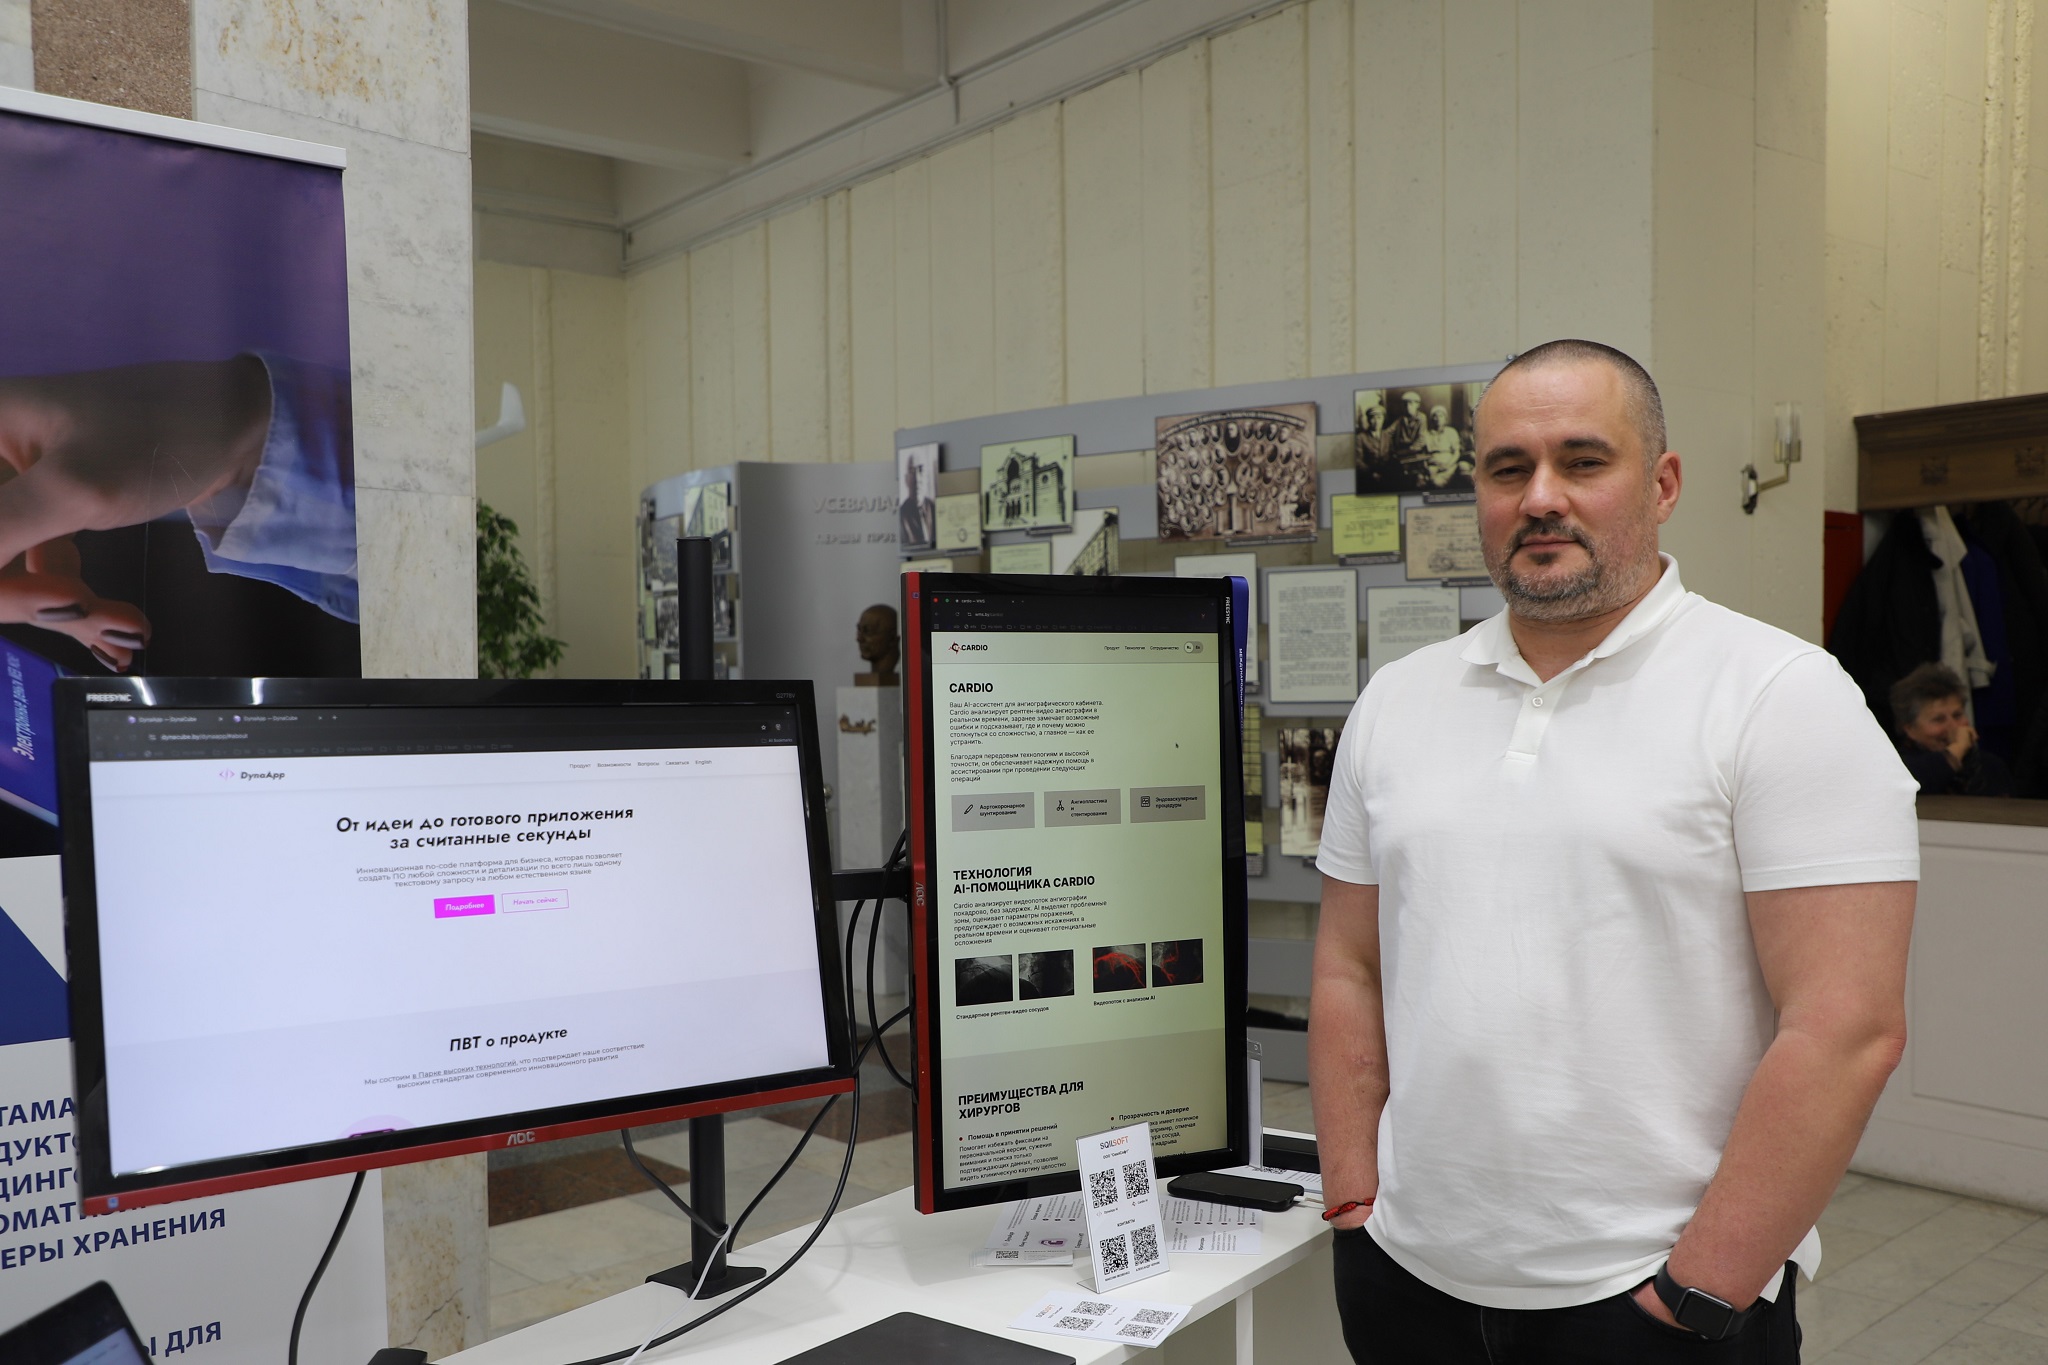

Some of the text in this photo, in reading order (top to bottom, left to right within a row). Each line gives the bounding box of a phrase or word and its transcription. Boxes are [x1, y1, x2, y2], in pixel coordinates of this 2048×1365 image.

[949, 683, 993, 693] CARDIO
[86, 692, 132, 702] FREESYNC
[1017, 700, 1075, 708] ангиографического
[1010, 708, 1054, 716] рентген-видео
[240, 771, 285, 781] DynaApp
[1014, 766, 1051, 774] проведении
[951, 775, 981, 783] операций
[337, 807, 633, 833] От идеи до готового приложения
[390, 829, 591, 849] за считанные секунды
[356, 864, 424, 874] Инновационная
[425, 861, 458, 870] no-code
[460, 859, 503, 869] платформа
[554, 855, 584, 863] которая
[585, 853, 623, 861] позволяет
[358, 874, 391, 882] создать
[392, 872, 406, 880] ПО
[407, 870, 435, 879] любой
[436, 869, 480, 877] сложности
[488, 866, 538, 875] детализации
[594, 861, 621, 869] одному
[395, 878, 441, 887] текстовому
[443, 876, 475, 885] запросу
[488, 873, 514, 881] любом
[516, 870, 568, 879] естественном
[953, 866, 1032, 881] ТЕХНОЛОГИЯ
[953, 875, 1095, 894] AI-ПОМОЩНИКА CARDIO
[445, 901, 485, 911] Подробнее
[536, 896, 558, 904] сейчас
[975, 900, 1013, 908] анализирует
[1050, 894, 1087, 903] ангиографии
[1071, 900, 1107, 909] проблемные
[972, 915, 1004, 923] оценивает
[1006, 913, 1039, 921] параметры
[1040, 911, 1074, 919] поражения,
[954, 923, 1002, 933] предупреждает
[954, 923, 1096, 940] реальном времени оценивает потенциальные
[954, 938, 992, 946] осложнения
[450, 1027, 567, 1052] ПВТ продукте
[365, 1077, 377, 1085] Мы
[379, 1073, 410, 1083] состоим
[419, 1069, 442, 1078] Парке
[443, 1065, 474, 1074] высоких
[475, 1058, 518, 1070] технологий,
[533, 1051, 581, 1063] подтверждает
[602, 1043, 645, 1054] соответствие
[397, 1053, 619, 1088] высоким стандартам современного инновационного развития
[958, 1081, 1084, 1106] ПРЕИМУЩЕСТВА ДЛЯ
[959, 1102, 1021, 1119] ХИРУРГОВ
[1118, 1106, 1189, 1122] Прозрачность доверие
[507, 1131, 535, 1146] AOC
[968, 1123, 1058, 1140] Помощь принятии решений
[959, 1136, 1041, 1152] Помогает избежать фиксации
[960, 1142, 1052, 1159] первоначальной версии, сужения
[960, 1158, 987, 1166] внимания
[960, 1156, 1058, 1174] подтверждающих данных, позволяя
[960, 1161, 1067, 1181] видеть клиническую картину целостно
[2, 1208, 226, 1270] ЕРЫ ХРАНЕНИЯ
[165, 1321, 222, 1358] ДЛЯ
